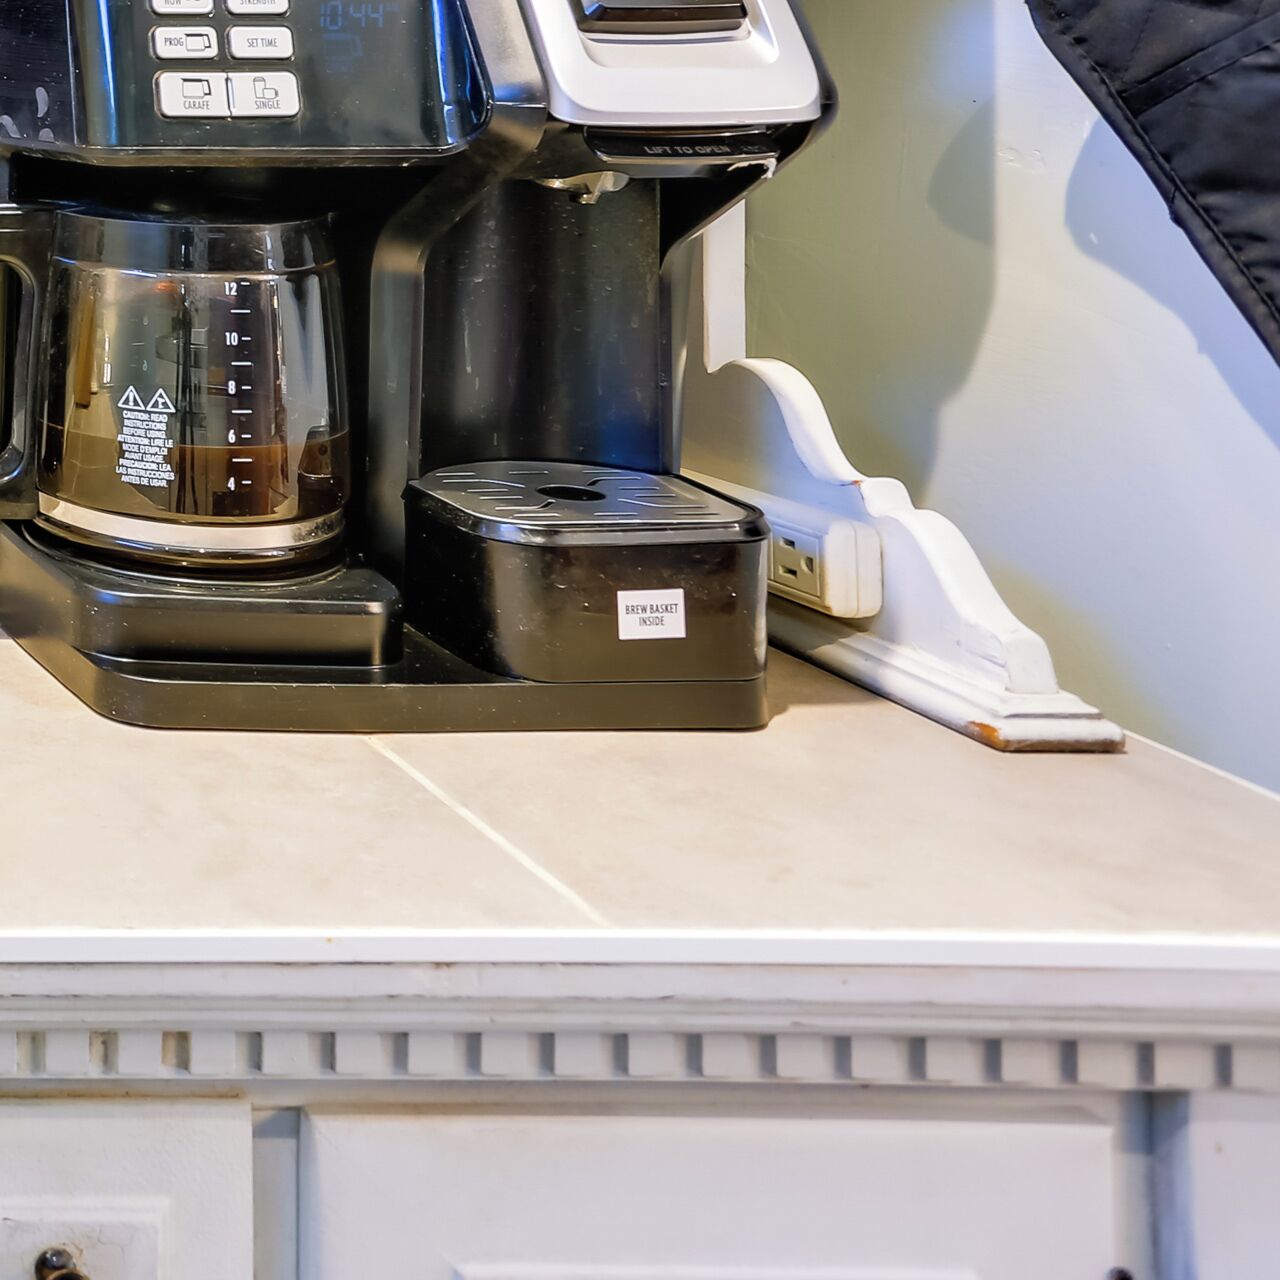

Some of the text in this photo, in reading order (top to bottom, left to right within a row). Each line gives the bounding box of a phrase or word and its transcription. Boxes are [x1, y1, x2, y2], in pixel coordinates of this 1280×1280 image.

[164, 37, 184, 47] PROG
[247, 38, 278, 48] SET TIME
[183, 100, 210, 110] CARAFE
[255, 99, 281, 110] SINGLE
[644, 145, 731, 154] LIFT TO OPEN
[224, 281, 238, 296] 12
[225, 331, 239, 346] 10
[228, 380, 236, 395] 8
[124, 419, 166, 430] INSTRUCTIONS
[228, 429, 236, 443] 6
[227, 477, 235, 491] 4
[625, 603, 678, 615] BREW BASKET
[639, 616, 665, 626] INSIDE
